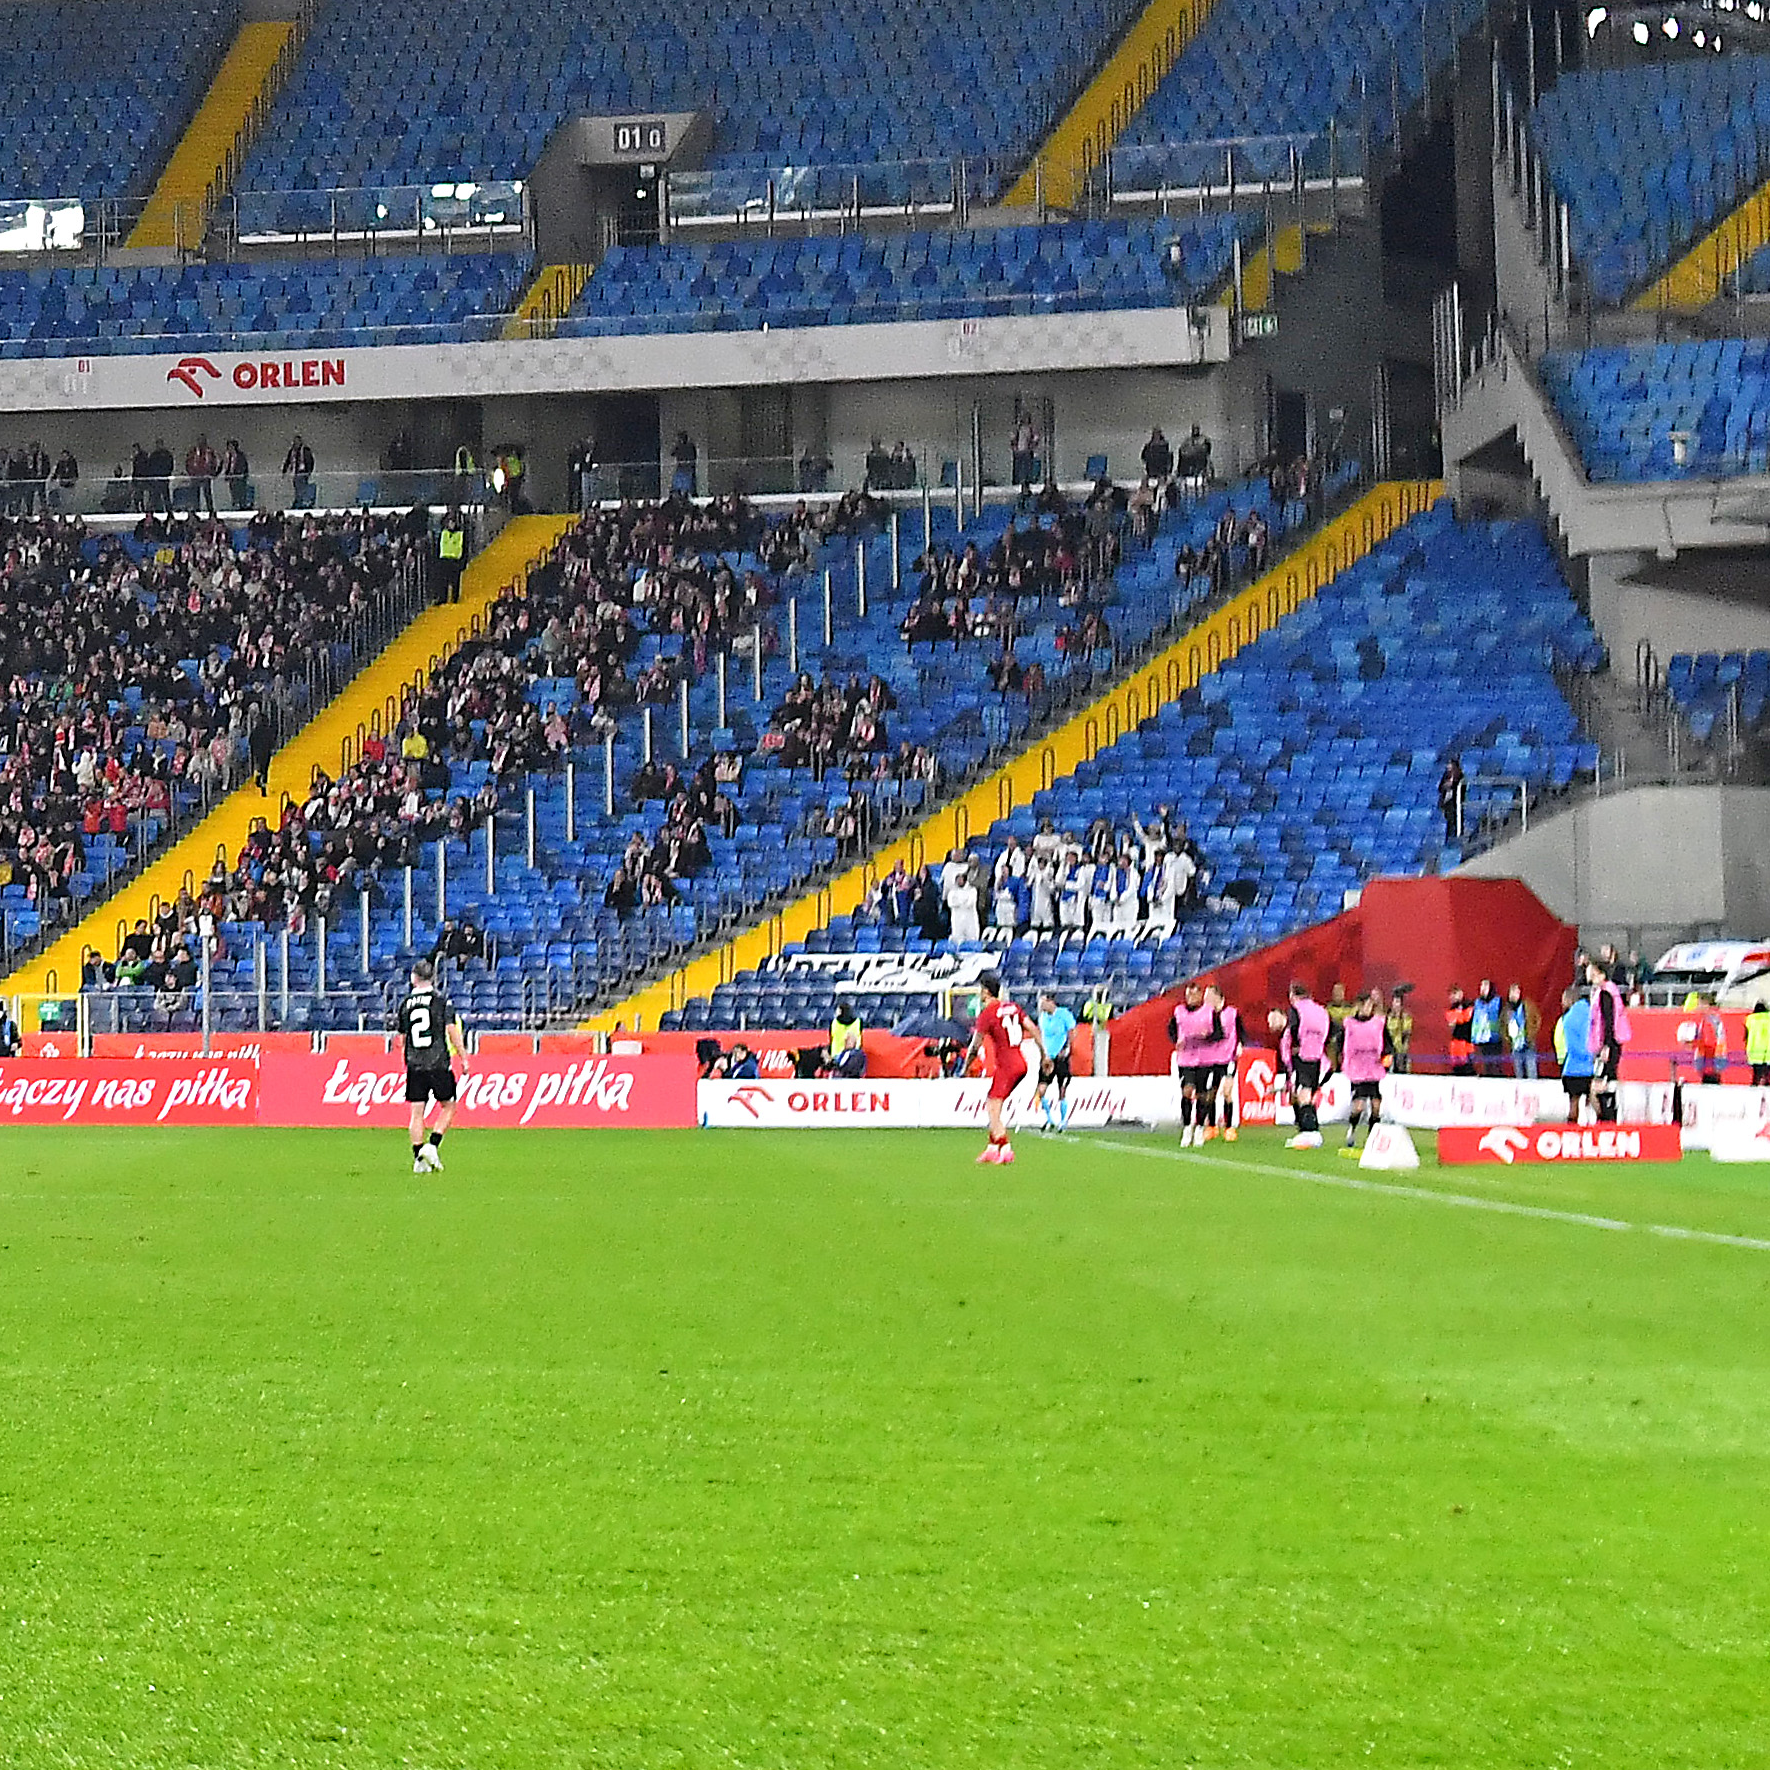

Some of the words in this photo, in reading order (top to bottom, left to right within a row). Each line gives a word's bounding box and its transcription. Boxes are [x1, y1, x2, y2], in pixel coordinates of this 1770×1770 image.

[618, 128, 640, 149] 01
[233, 359, 346, 389] ORLEN
[409, 1008, 434, 1048] 2
[90, 1078, 155, 1110] nas
[157, 1067, 252, 1121] piłka
[322, 1059, 435, 1119] Łącz
[455, 1072, 529, 1111] nas
[519, 1059, 635, 1125] piłka
[787, 1091, 890, 1113] ORLEN
[1536, 1130, 1641, 1160] ORLEN
